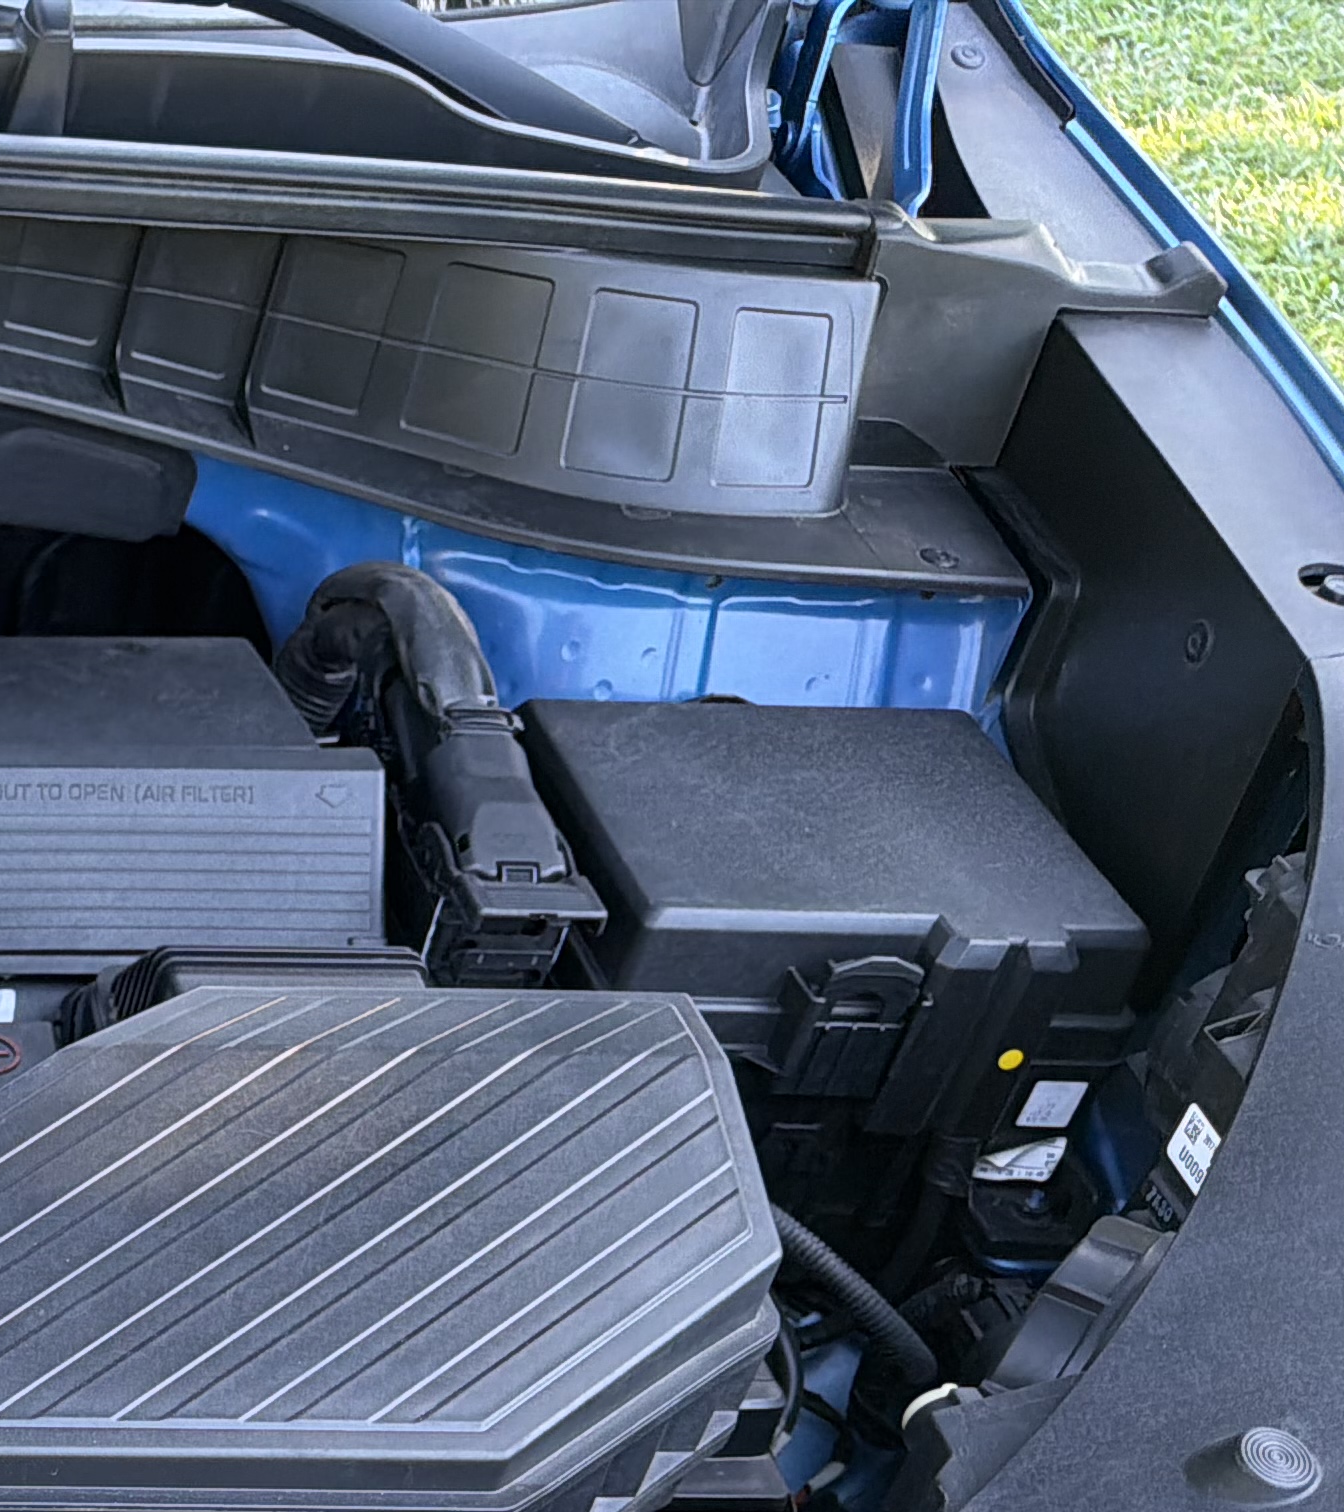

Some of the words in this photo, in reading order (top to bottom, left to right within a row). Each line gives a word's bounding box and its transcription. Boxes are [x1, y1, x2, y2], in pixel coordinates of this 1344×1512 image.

[36, 783, 62, 802] TO
[68, 783, 124, 803] OPEN
[1178, 1145, 1205, 1184] U009
